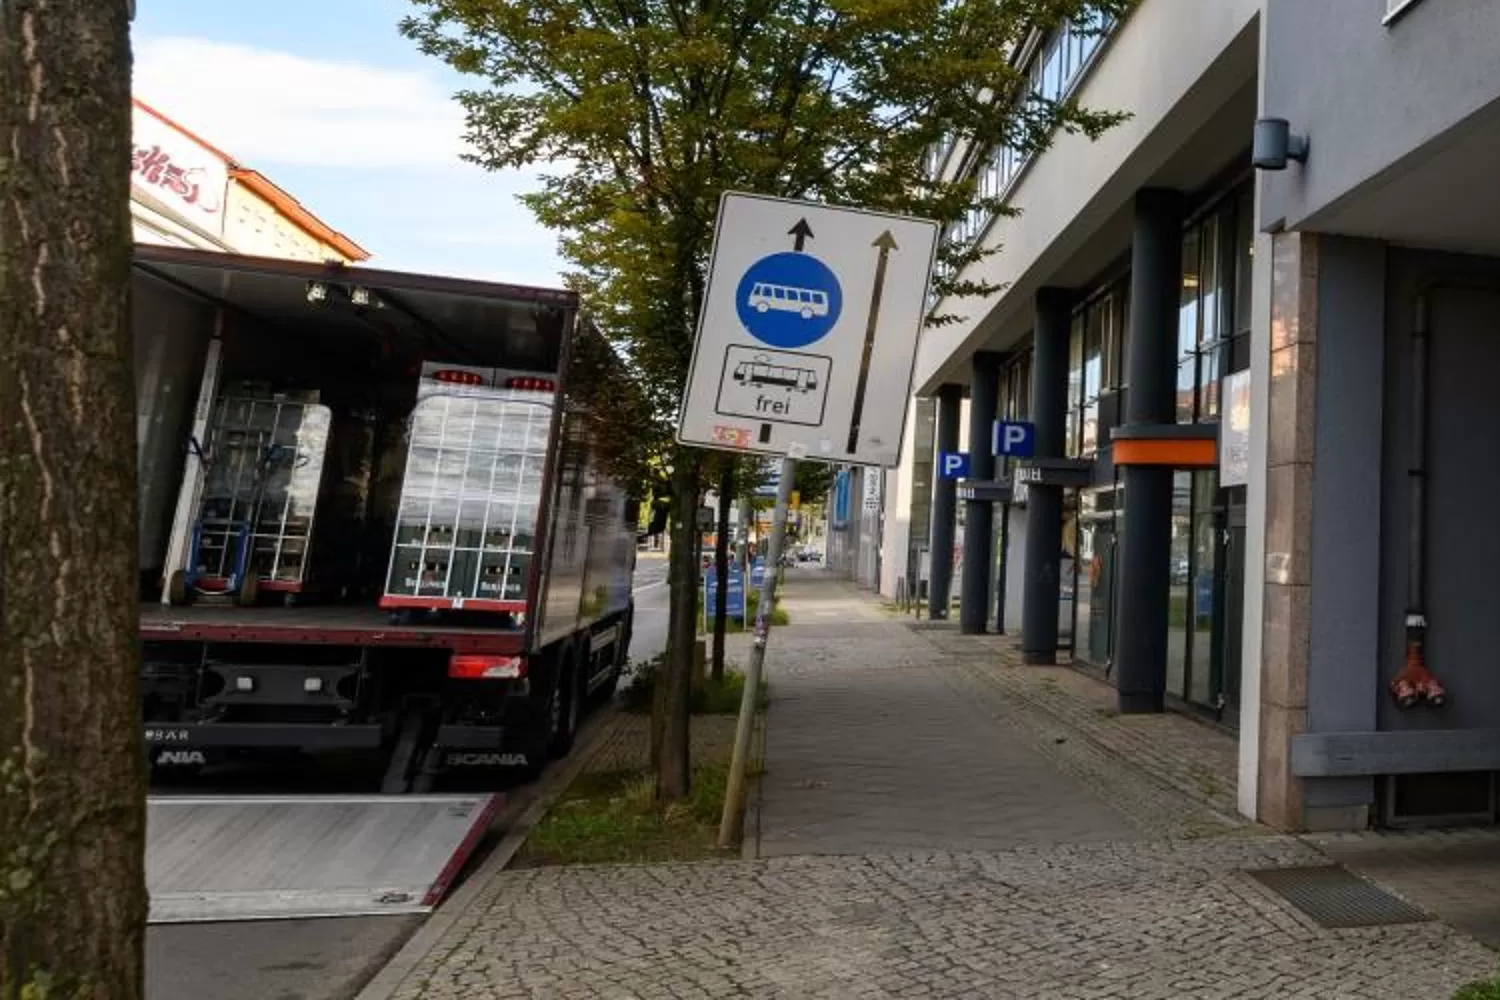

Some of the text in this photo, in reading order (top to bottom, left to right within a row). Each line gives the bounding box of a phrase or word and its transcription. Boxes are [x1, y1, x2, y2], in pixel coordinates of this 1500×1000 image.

[756, 394, 791, 415] frei
[1003, 425, 1026, 453] P
[945, 455, 963, 475] P
[447, 752, 529, 766] SCANIA
